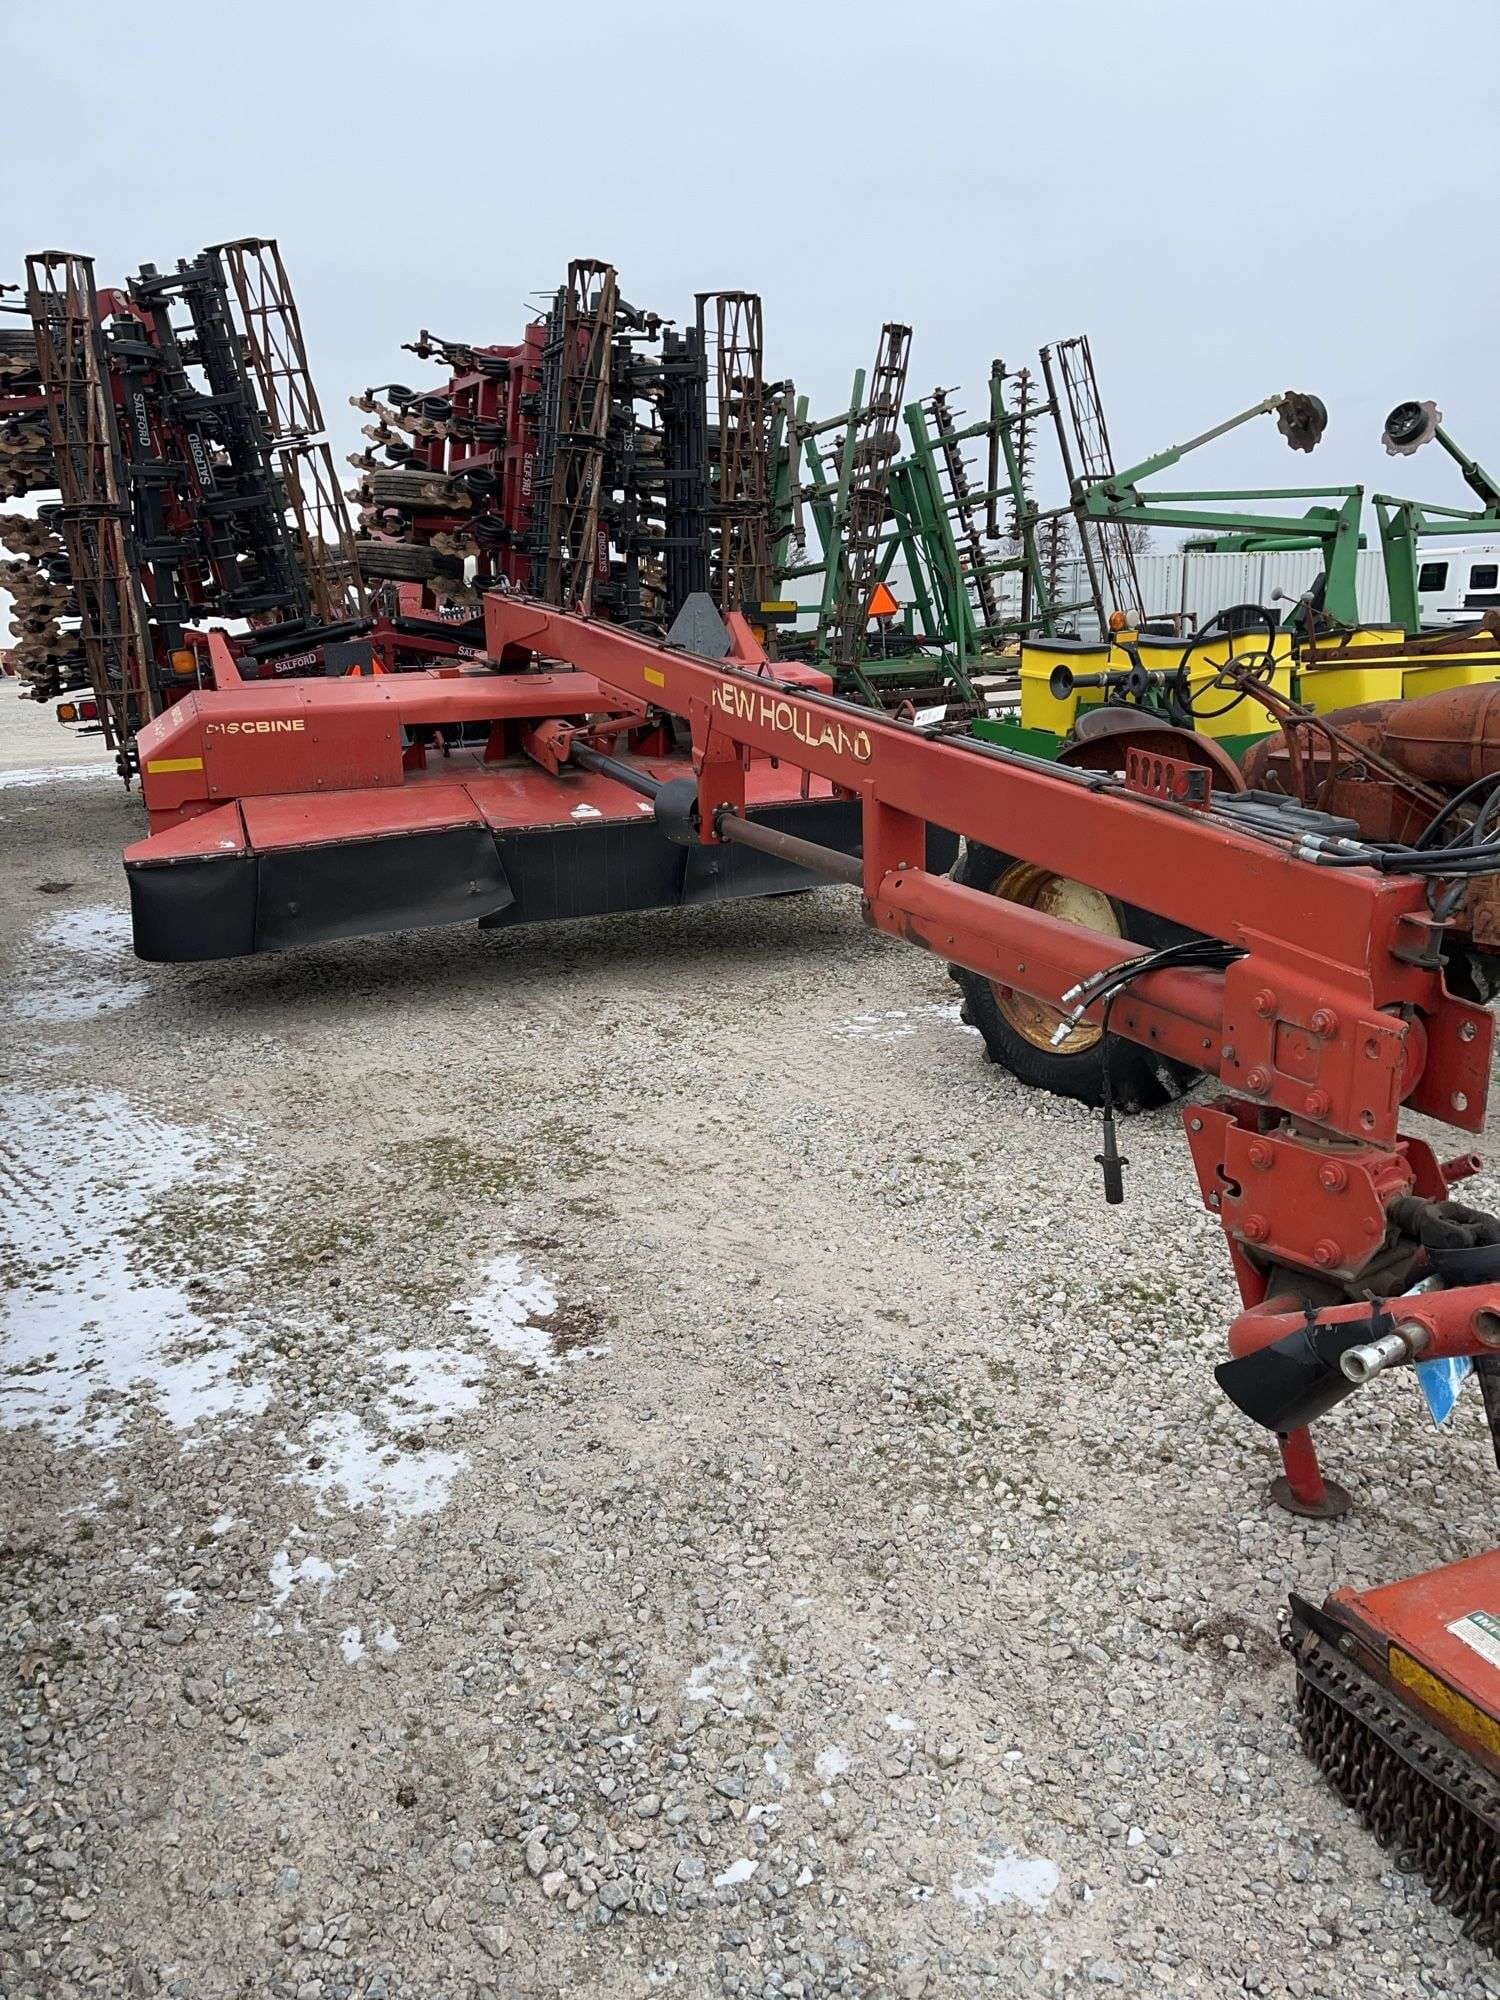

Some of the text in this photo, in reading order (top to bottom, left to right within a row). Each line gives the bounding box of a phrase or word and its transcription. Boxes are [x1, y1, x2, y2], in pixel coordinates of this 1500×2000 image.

[133, 393, 151, 447] SALFORD
[188, 433, 211, 485] SALFORD
[598, 531, 608, 572] SALFORD
[275, 653, 317, 673] SALFORD
[206, 719, 305, 735] DISCBINE
[712, 682, 871, 760] NEW HOLLAND
